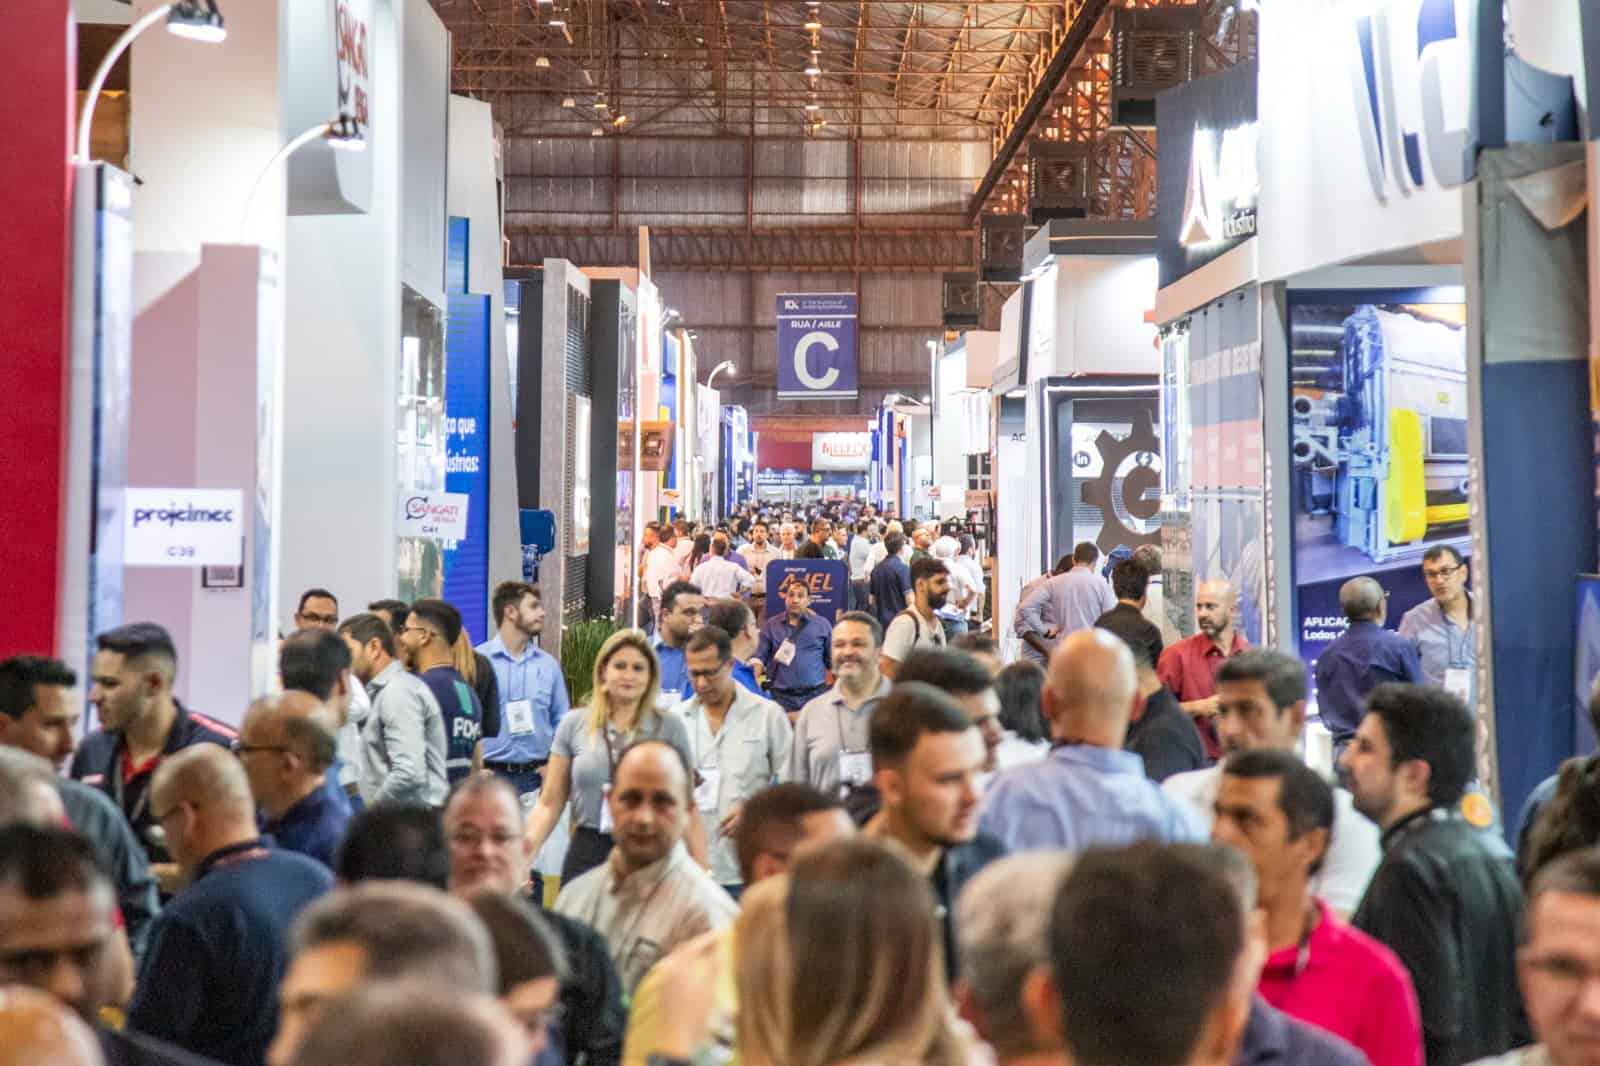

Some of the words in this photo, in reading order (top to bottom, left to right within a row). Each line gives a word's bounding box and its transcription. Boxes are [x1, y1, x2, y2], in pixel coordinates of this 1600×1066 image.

[791, 319, 809, 329] RUA
[818, 319, 842, 329] AISLE
[794, 331, 841, 390] C
[458, 417, 477, 441] que
